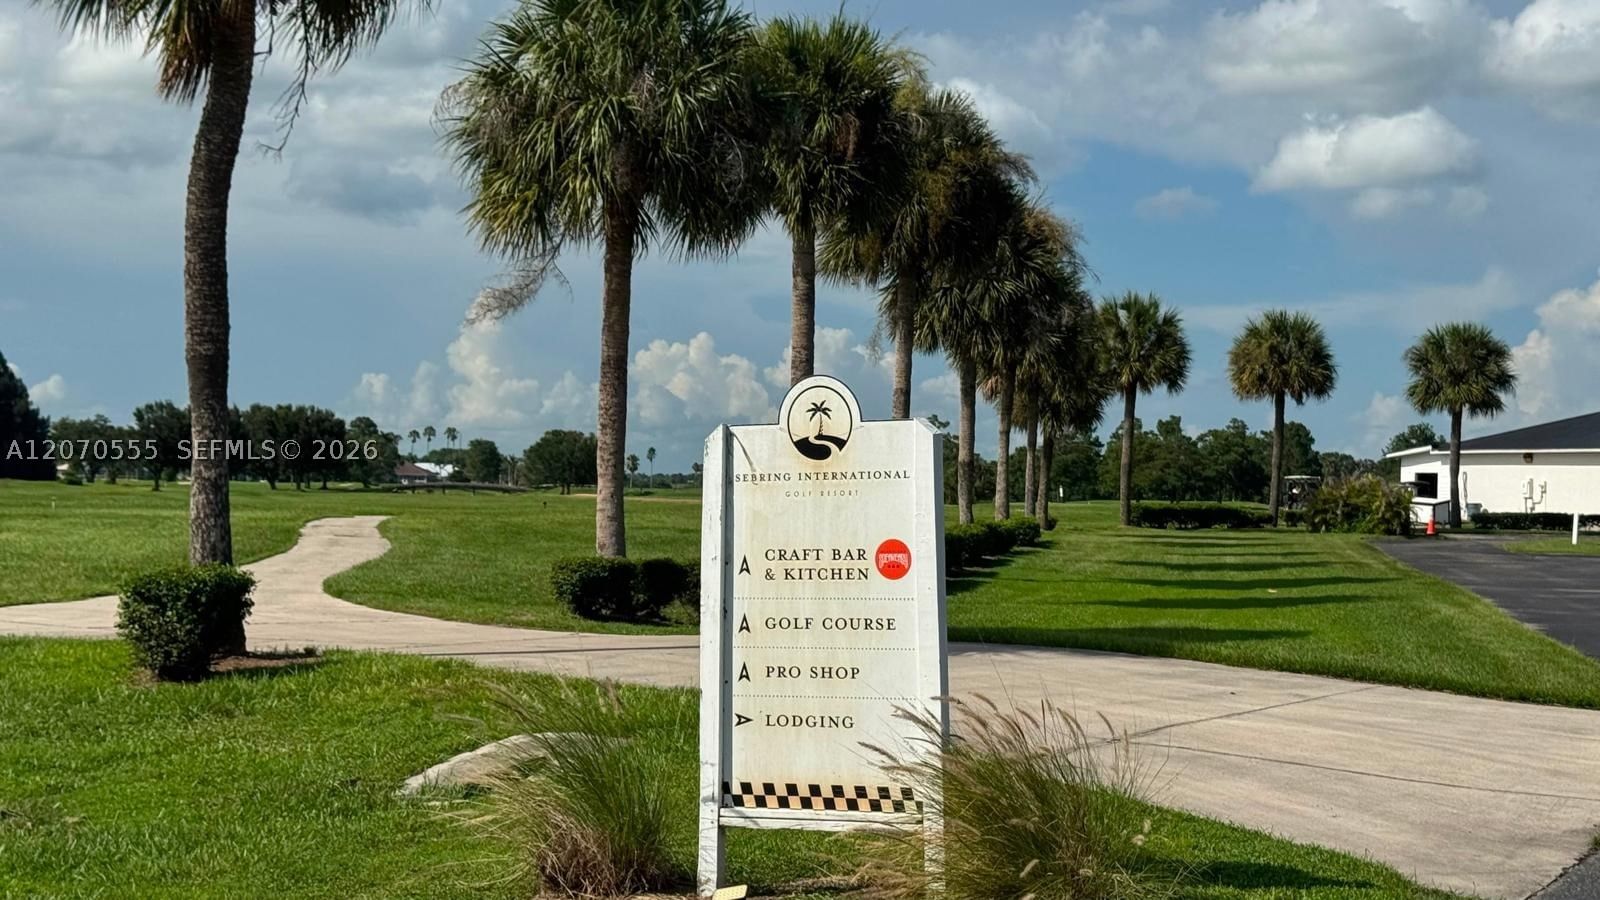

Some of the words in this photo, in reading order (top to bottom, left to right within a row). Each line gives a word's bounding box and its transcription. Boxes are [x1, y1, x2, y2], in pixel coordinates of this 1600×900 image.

[735, 472, 792, 483] SEBRING
[798, 470, 911, 482] INTERNATIONAL
[785, 490, 813, 498] GOLF
[820, 489, 859, 497] RESORT
[764, 548, 823, 561] CRAFT
[831, 548, 868, 561] BAR
[764, 568, 776, 581] &
[784, 567, 870, 581] KITCHEN
[765, 617, 814, 630] GOLF
[822, 617, 897, 631] COURSE
[765, 665, 801, 679] PRO
[809, 666, 861, 680] SHOP
[765, 714, 855, 729] LODGING
